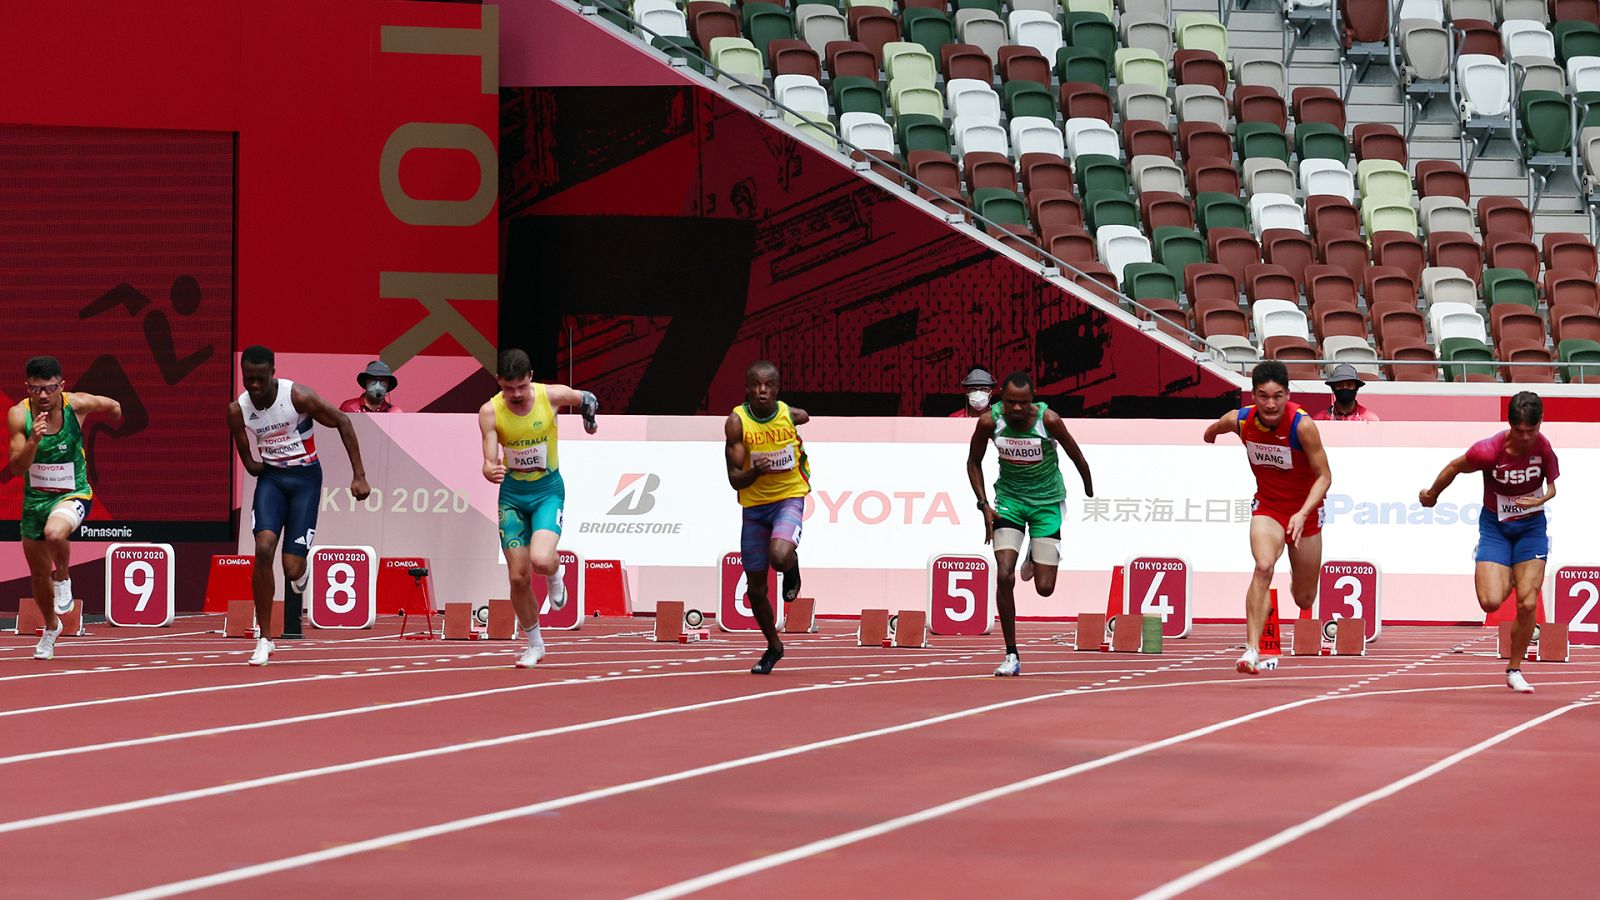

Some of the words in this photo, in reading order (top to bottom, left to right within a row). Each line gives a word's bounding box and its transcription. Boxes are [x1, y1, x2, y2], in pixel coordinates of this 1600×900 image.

[265, 436, 291, 445] TOYOTA
[744, 427, 793, 445] BENIN
[1255, 444, 1281, 453] TOYOTA
[514, 456, 540, 466] PAGE
[1254, 452, 1284, 465] WANG
[1492, 465, 1541, 484] USA
[390, 487, 470, 514] 2020
[80, 525, 132, 537] Panasonic
[578, 522, 682, 535] BRIDGESTONE
[115, 551, 142, 559] TOKYO
[143, 551, 164, 560] 2020
[317, 552, 344, 561] TOKYO
[345, 553, 366, 561] 2020
[937, 561, 964, 570] TOKYO
[965, 562, 986, 571] 2020
[1134, 561, 1161, 570] TOKYO
[1162, 562, 1183, 571] 2020
[1324, 565, 1352, 574] TOKYO
[1352, 566, 1374, 575] 2020
[1559, 570, 1588, 579] TOKYO
[124, 560, 155, 612] 9
[325, 562, 357, 614] 8
[944, 570, 975, 622] 5
[1140, 571, 1174, 623] 4
[1331, 575, 1364, 622] 3
[1568, 581, 1600, 632] 2
